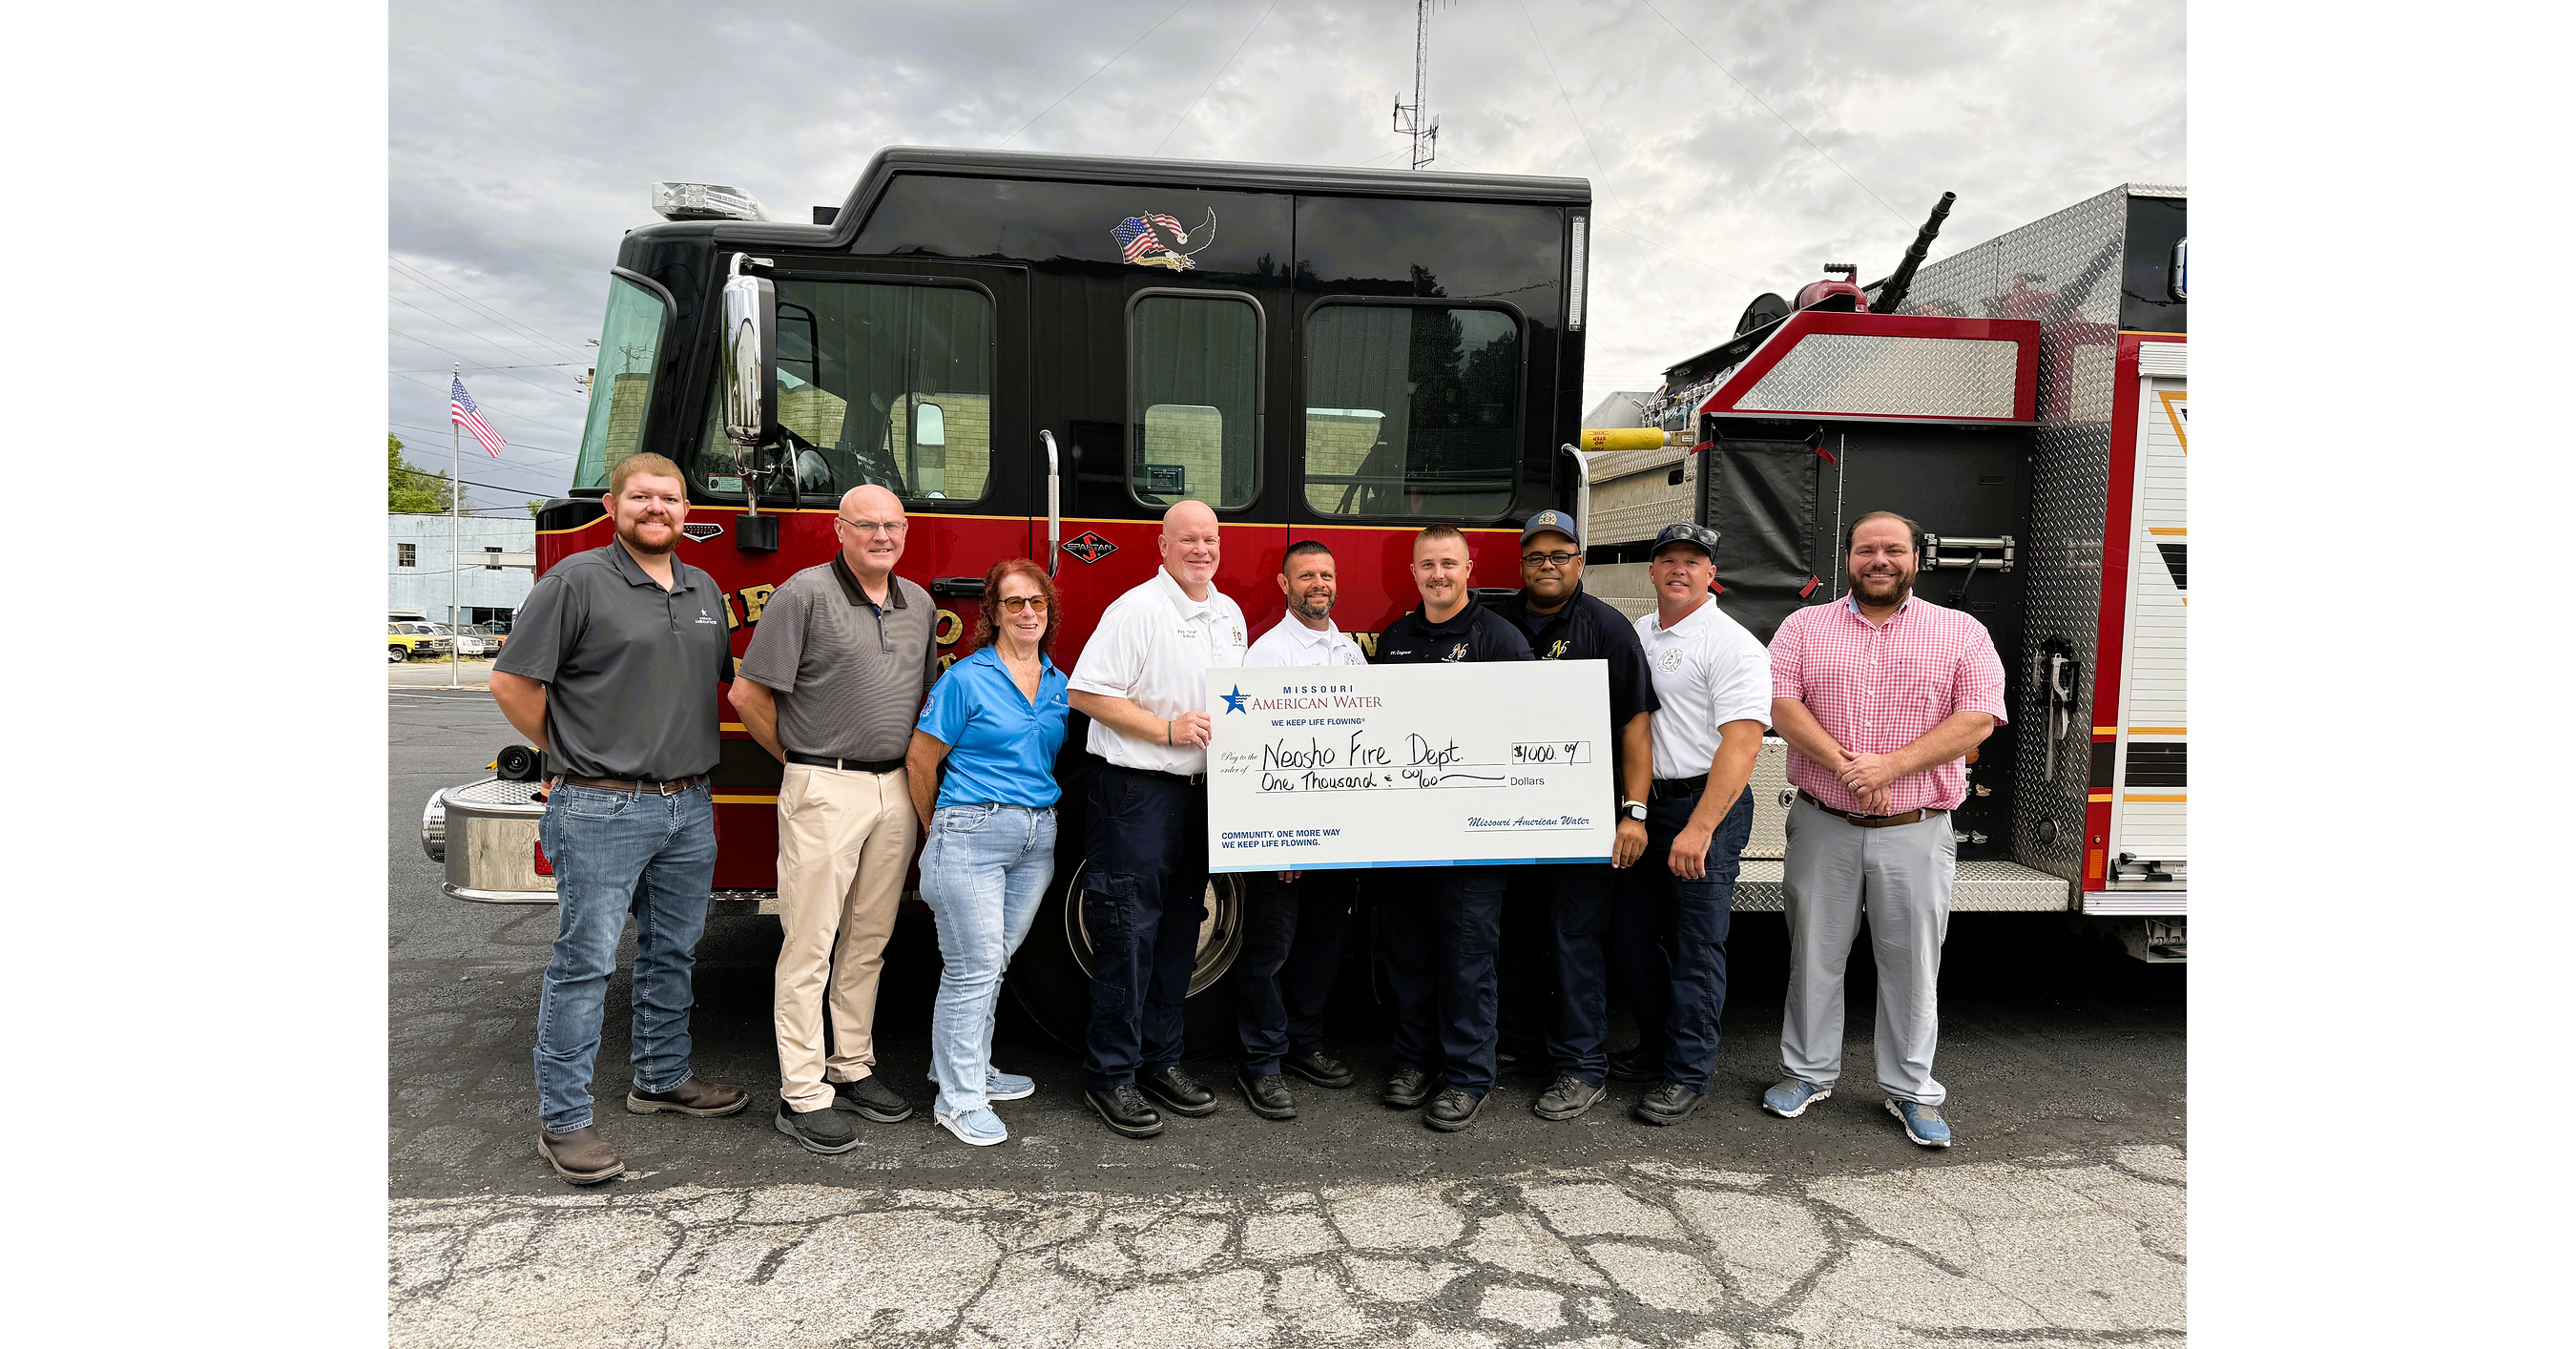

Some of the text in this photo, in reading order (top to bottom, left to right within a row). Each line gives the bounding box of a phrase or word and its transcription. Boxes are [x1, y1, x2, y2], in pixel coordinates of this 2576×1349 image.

[1067, 543, 1112, 551] SPARTAN
[1282, 685, 1354, 695] MISSOURI
[1252, 695, 1383, 711] AMERICAN WATER
[1220, 750, 1239, 764] Pay
[1248, 752, 1258, 761] the
[1262, 729, 1464, 772] Neosho Fire Dept.
[1239, 764, 1250, 776] of
[1261, 772, 1295, 791] One
[1300, 770, 1378, 791] Thousand
[1509, 776, 1546, 786] Dollars
[1467, 814, 1590, 828] Missouri American Water
[1221, 828, 1341, 841] COMMUNITY. ONE MORE WAY
[1221, 839, 1321, 849] WE KEEP LIFE FLOWING.
